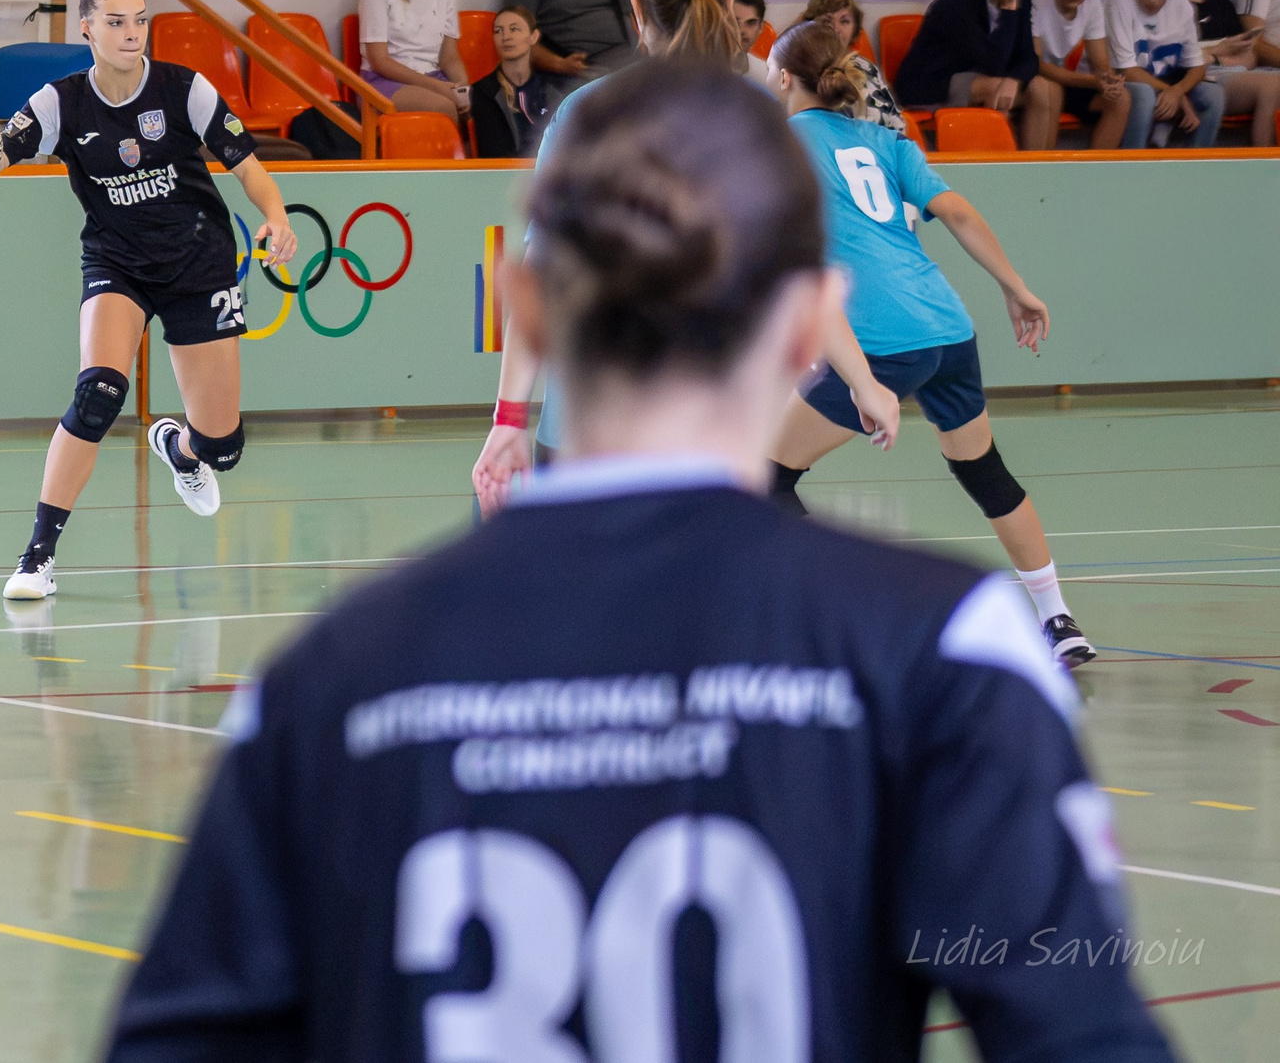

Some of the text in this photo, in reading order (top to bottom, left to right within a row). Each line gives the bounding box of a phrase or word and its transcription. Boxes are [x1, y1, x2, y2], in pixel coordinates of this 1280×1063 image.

[834, 146, 894, 223] 6
[210, 286, 245, 331] 25
[395, 815, 809, 1063] 30
